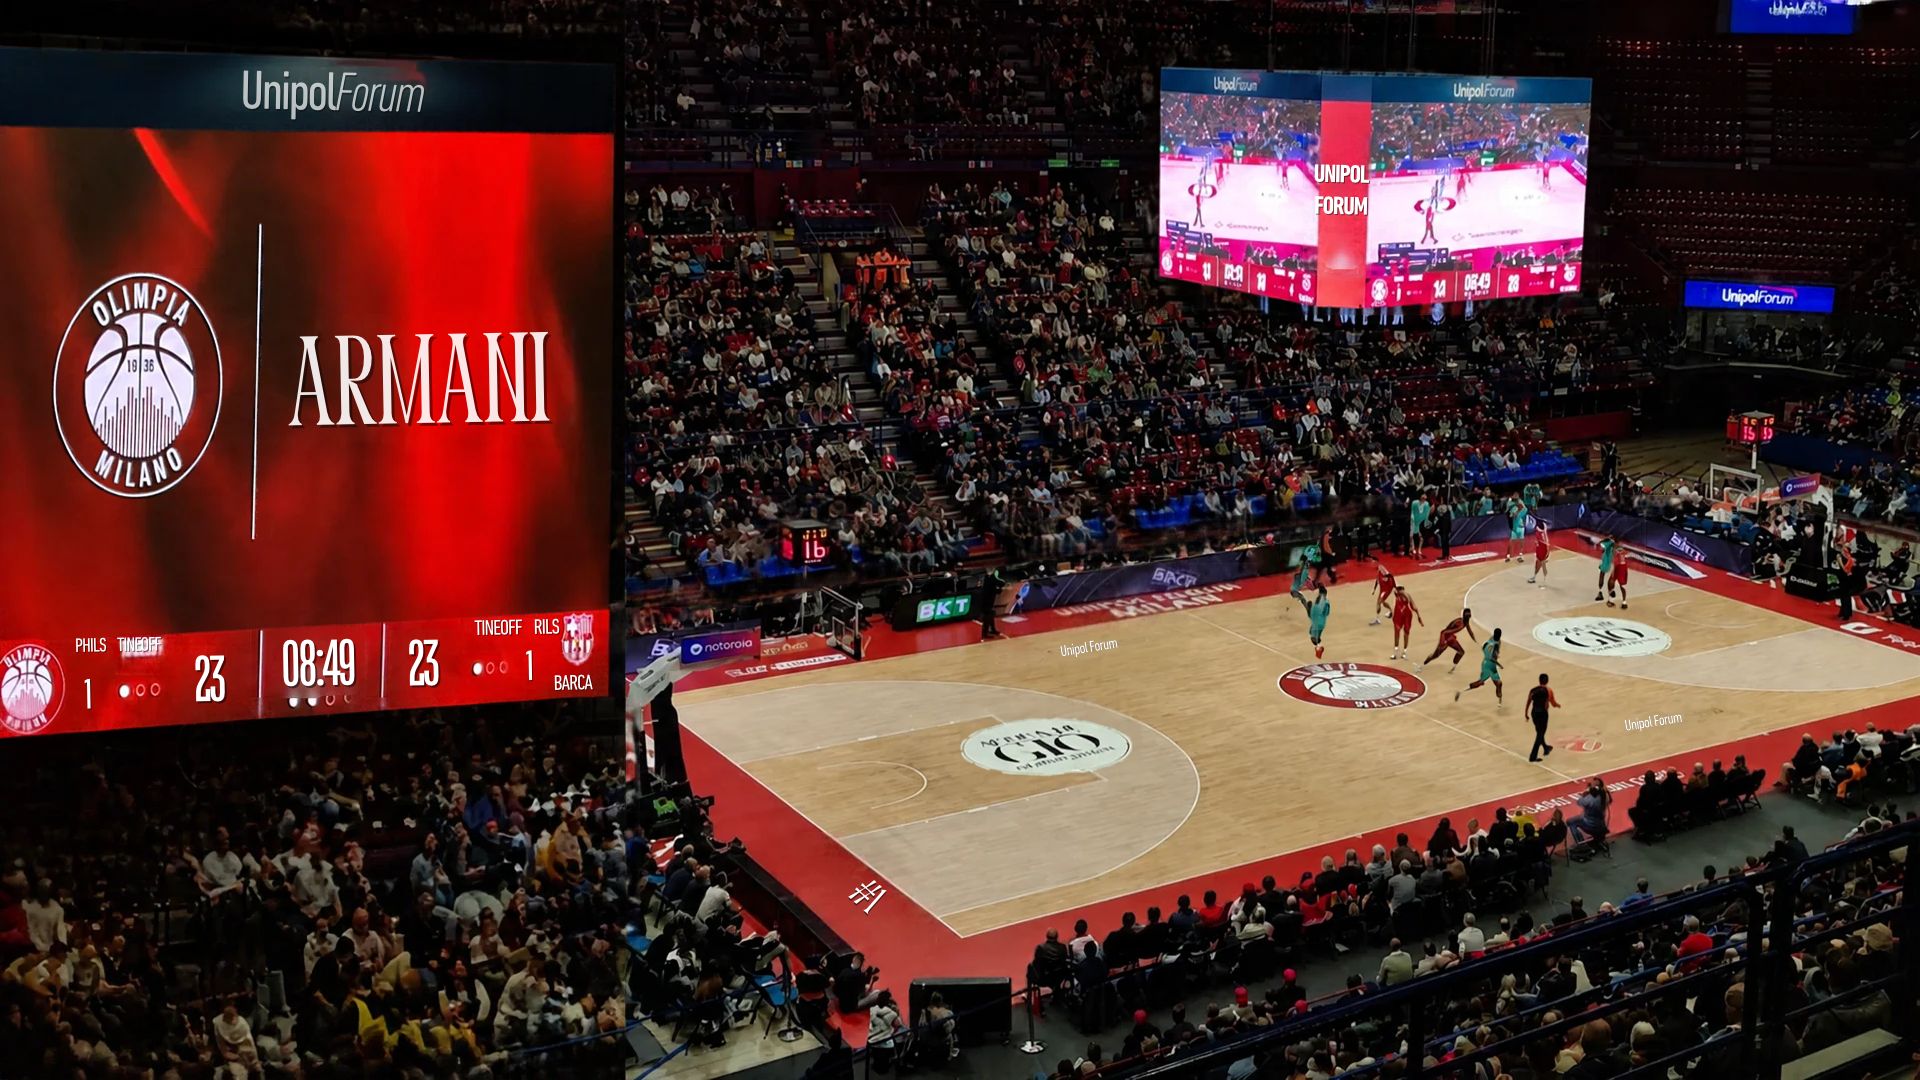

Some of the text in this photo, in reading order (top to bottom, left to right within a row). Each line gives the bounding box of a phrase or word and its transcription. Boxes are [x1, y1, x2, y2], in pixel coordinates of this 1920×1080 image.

[1314, 164, 1370, 184] UNIPOL
[1315, 195, 1368, 216] FORUM
[92, 282, 190, 327] OLIMPIA
[288, 331, 550, 426] ARMANI
[94, 447, 182, 488] MILANO
[919, 598, 969, 619] BKT
[75, 637, 107, 653] PHILS
[475, 619, 523, 636] TINEOFF
[534, 618, 560, 635] RILS
[1060, 639, 1118, 658] Unipol Forum
[194, 638, 440, 702] 23 08:49 23
[525, 650, 533, 681] 1
[84, 678, 92, 709] 1
[554, 674, 593, 691] BARCA
[1624, 714, 1683, 731] Unipol Forum
[848, 879, 887, 914] #1
